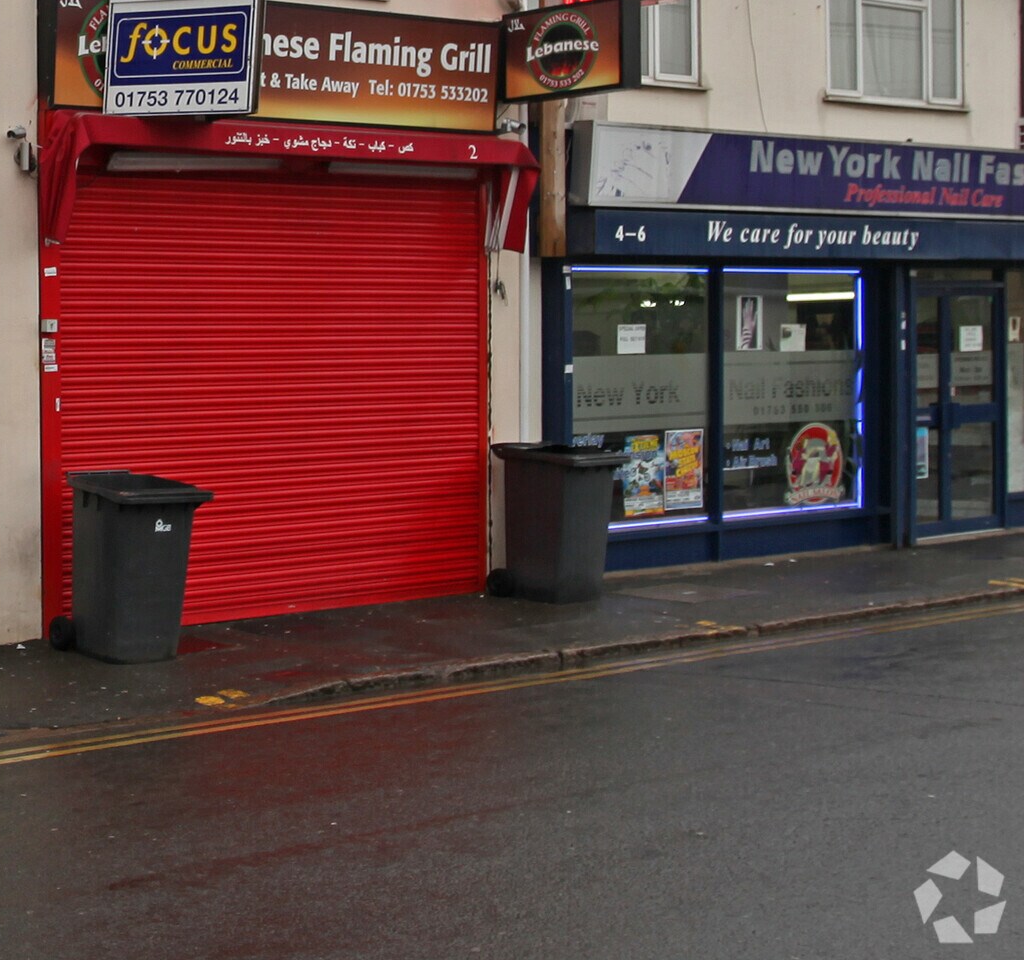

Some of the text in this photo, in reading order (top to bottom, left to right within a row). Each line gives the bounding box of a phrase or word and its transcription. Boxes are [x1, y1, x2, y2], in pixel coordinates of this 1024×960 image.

[533, 13, 590, 42] FLAMING GRILL
[172, 58, 234, 70] COMMERCIAL
[262, 31, 492, 78] nese Flaming Grill
[526, 40, 599, 62] Lebanese
[115, 88, 239, 107] 01753 770124
[270, 73, 281, 88] &
[285, 73, 317, 91] Take
[321, 76, 360, 98] Away
[368, 79, 394, 96] Tel:
[398, 82, 436, 99] 01753
[440, 85, 488, 103] 533202
[467, 144, 479, 160] 2
[749, 140, 1024, 186] New York Nail Fas
[844, 183, 1004, 208] Professional Nail Care
[706, 220, 919, 251] We care for your beauty
[576, 380, 680, 408] New York
[729, 376, 852, 401] Nail Fashions
